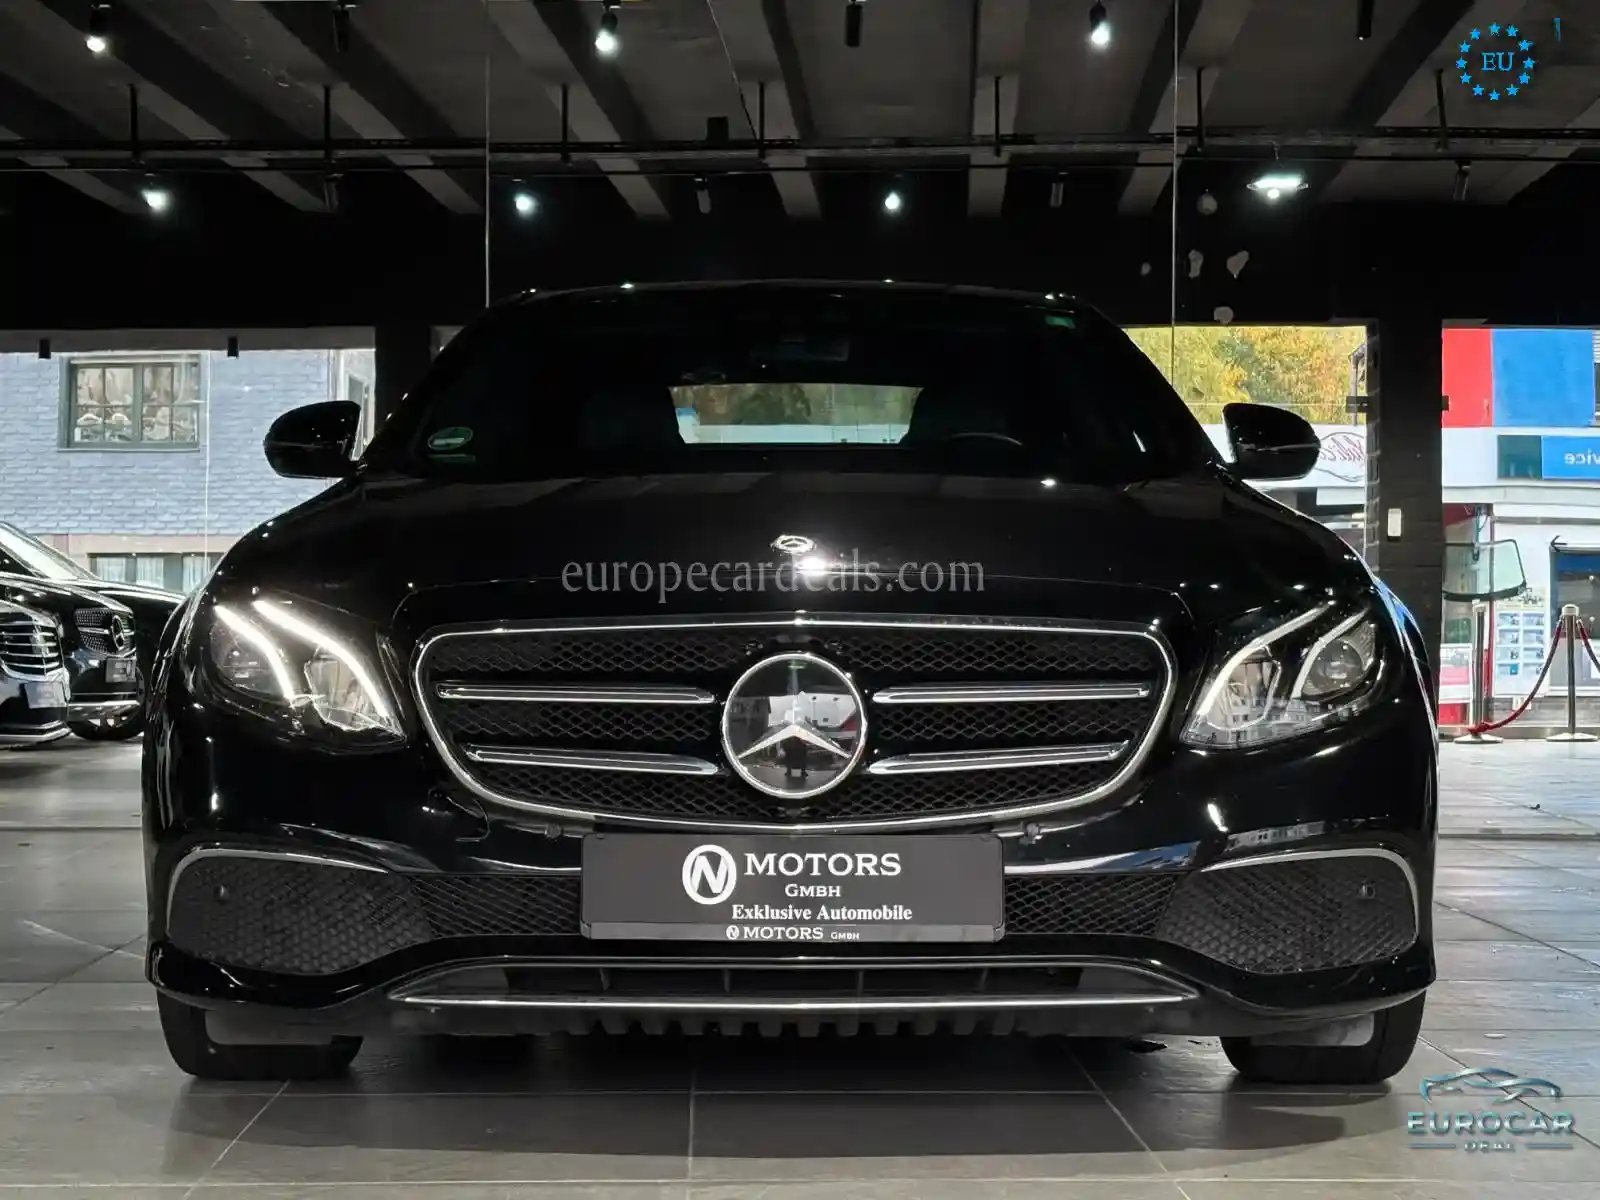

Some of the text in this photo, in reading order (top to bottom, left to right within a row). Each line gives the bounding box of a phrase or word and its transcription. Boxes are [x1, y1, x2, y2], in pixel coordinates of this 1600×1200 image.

[744, 852, 902, 876] MOTORS
[785, 883, 841, 897] GMBH
[731, 903, 913, 920] Exklusive Automobile
[743, 926, 824, 940] MOTORS
